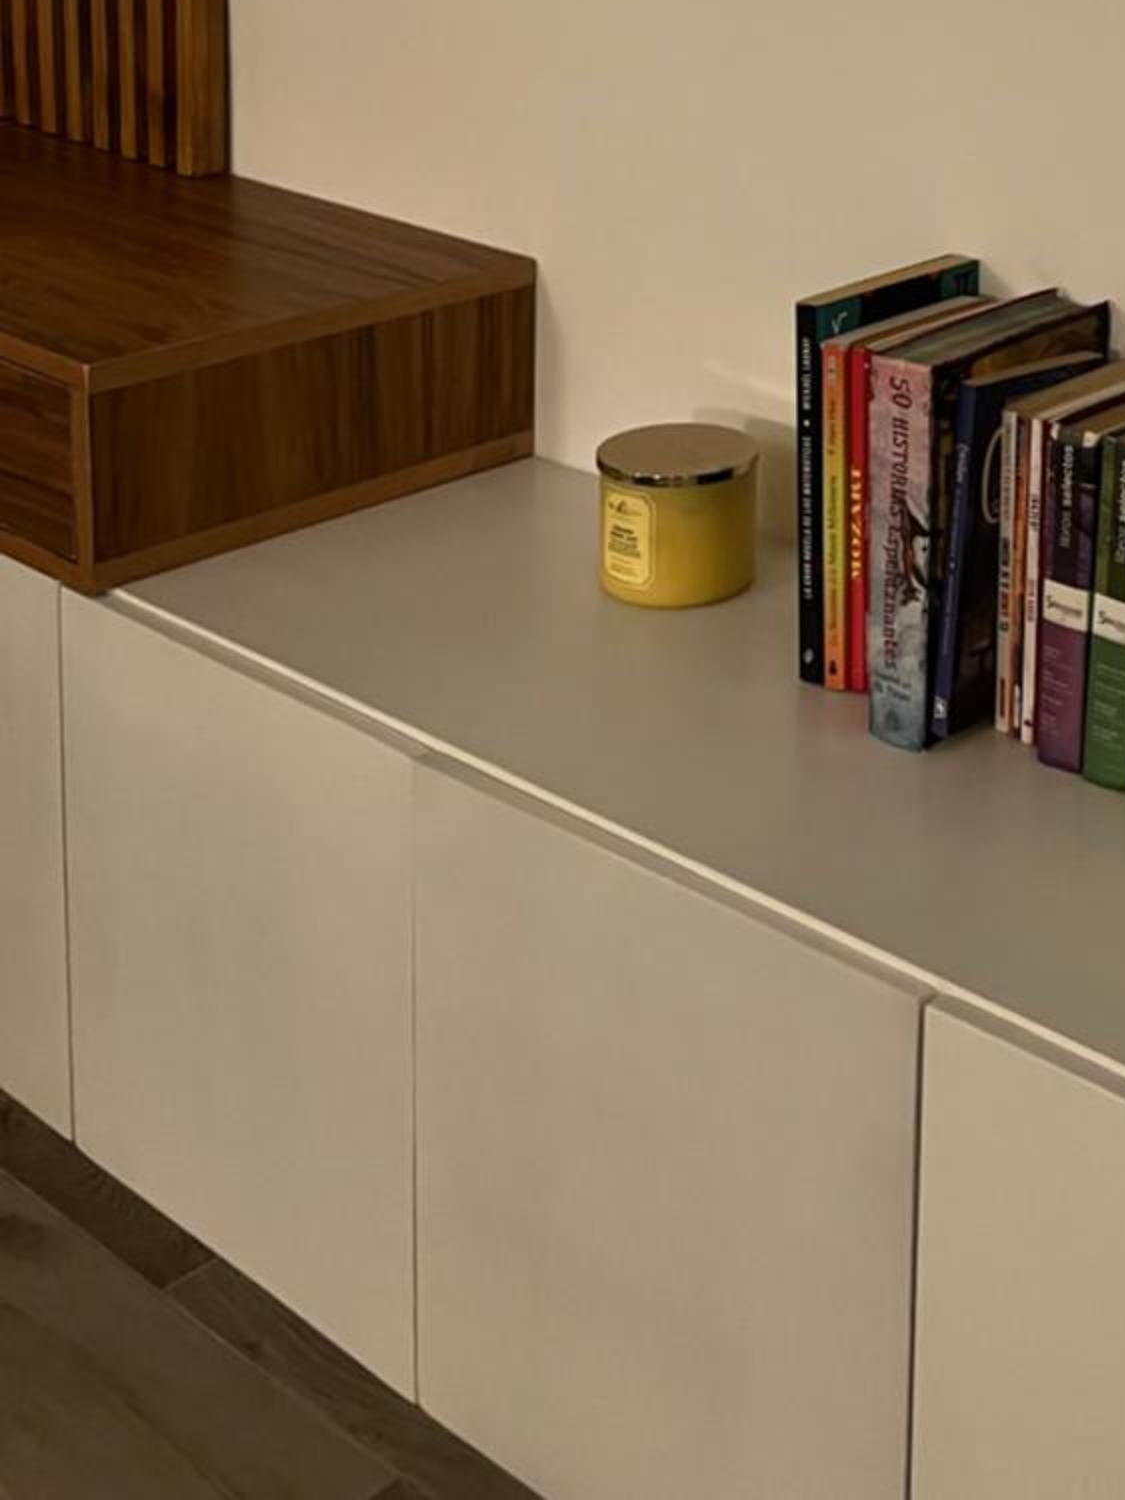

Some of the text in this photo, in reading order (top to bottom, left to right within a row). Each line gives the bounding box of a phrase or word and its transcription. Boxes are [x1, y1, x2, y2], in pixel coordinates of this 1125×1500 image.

[889, 376, 913, 410] 50
[1060, 444, 1075, 507] selectos
[850, 467, 864, 581] MOZART
